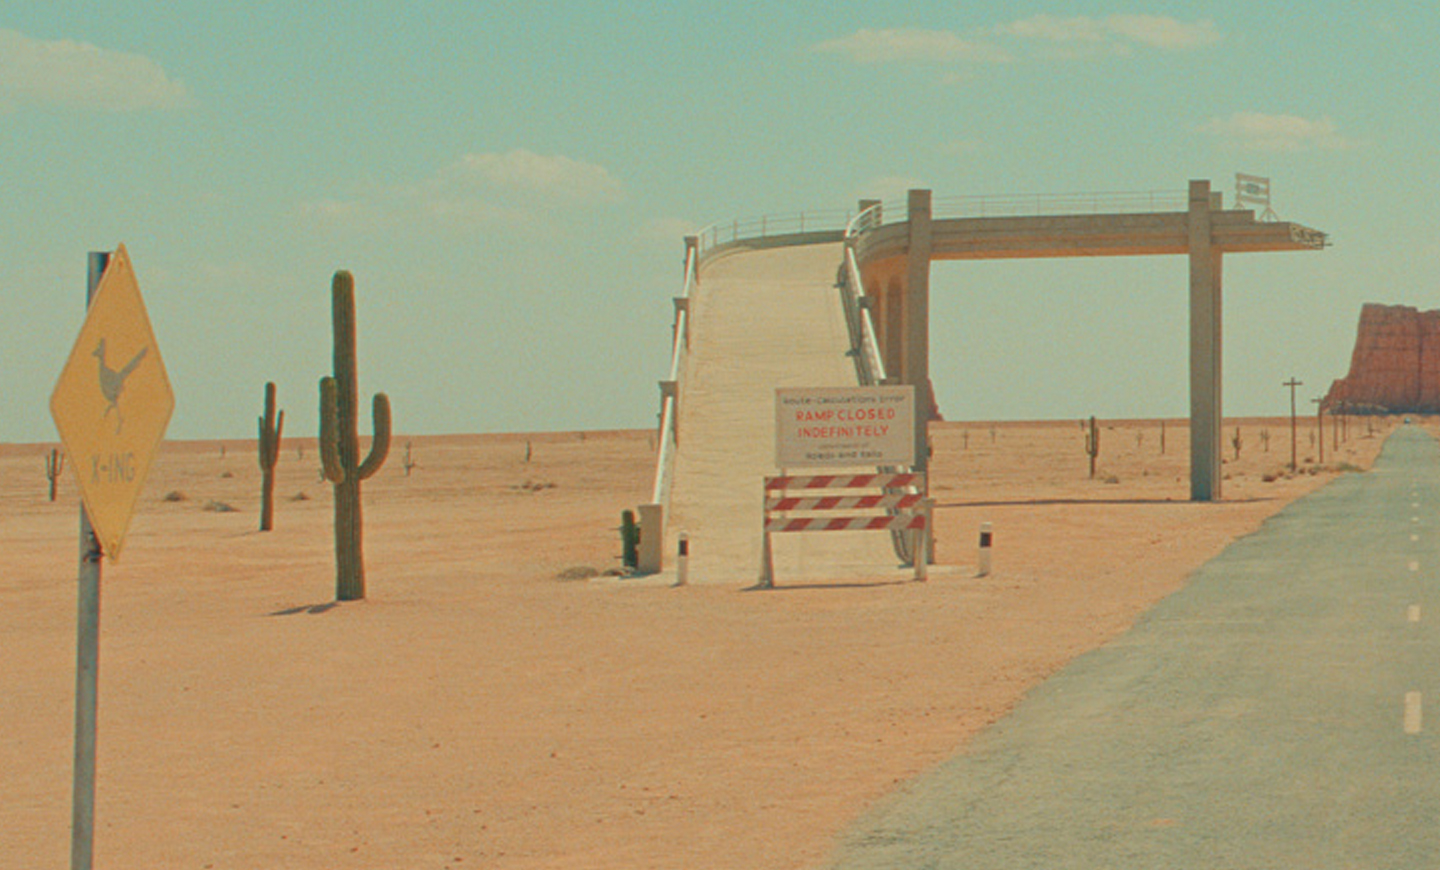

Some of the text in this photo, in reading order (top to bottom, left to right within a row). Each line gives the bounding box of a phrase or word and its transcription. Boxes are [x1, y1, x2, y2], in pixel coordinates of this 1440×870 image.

[795, 407, 896, 421] RAMP CLOSED
[797, 425, 890, 438] INDEFINITELY
[91, 452, 135, 484] X-ING
